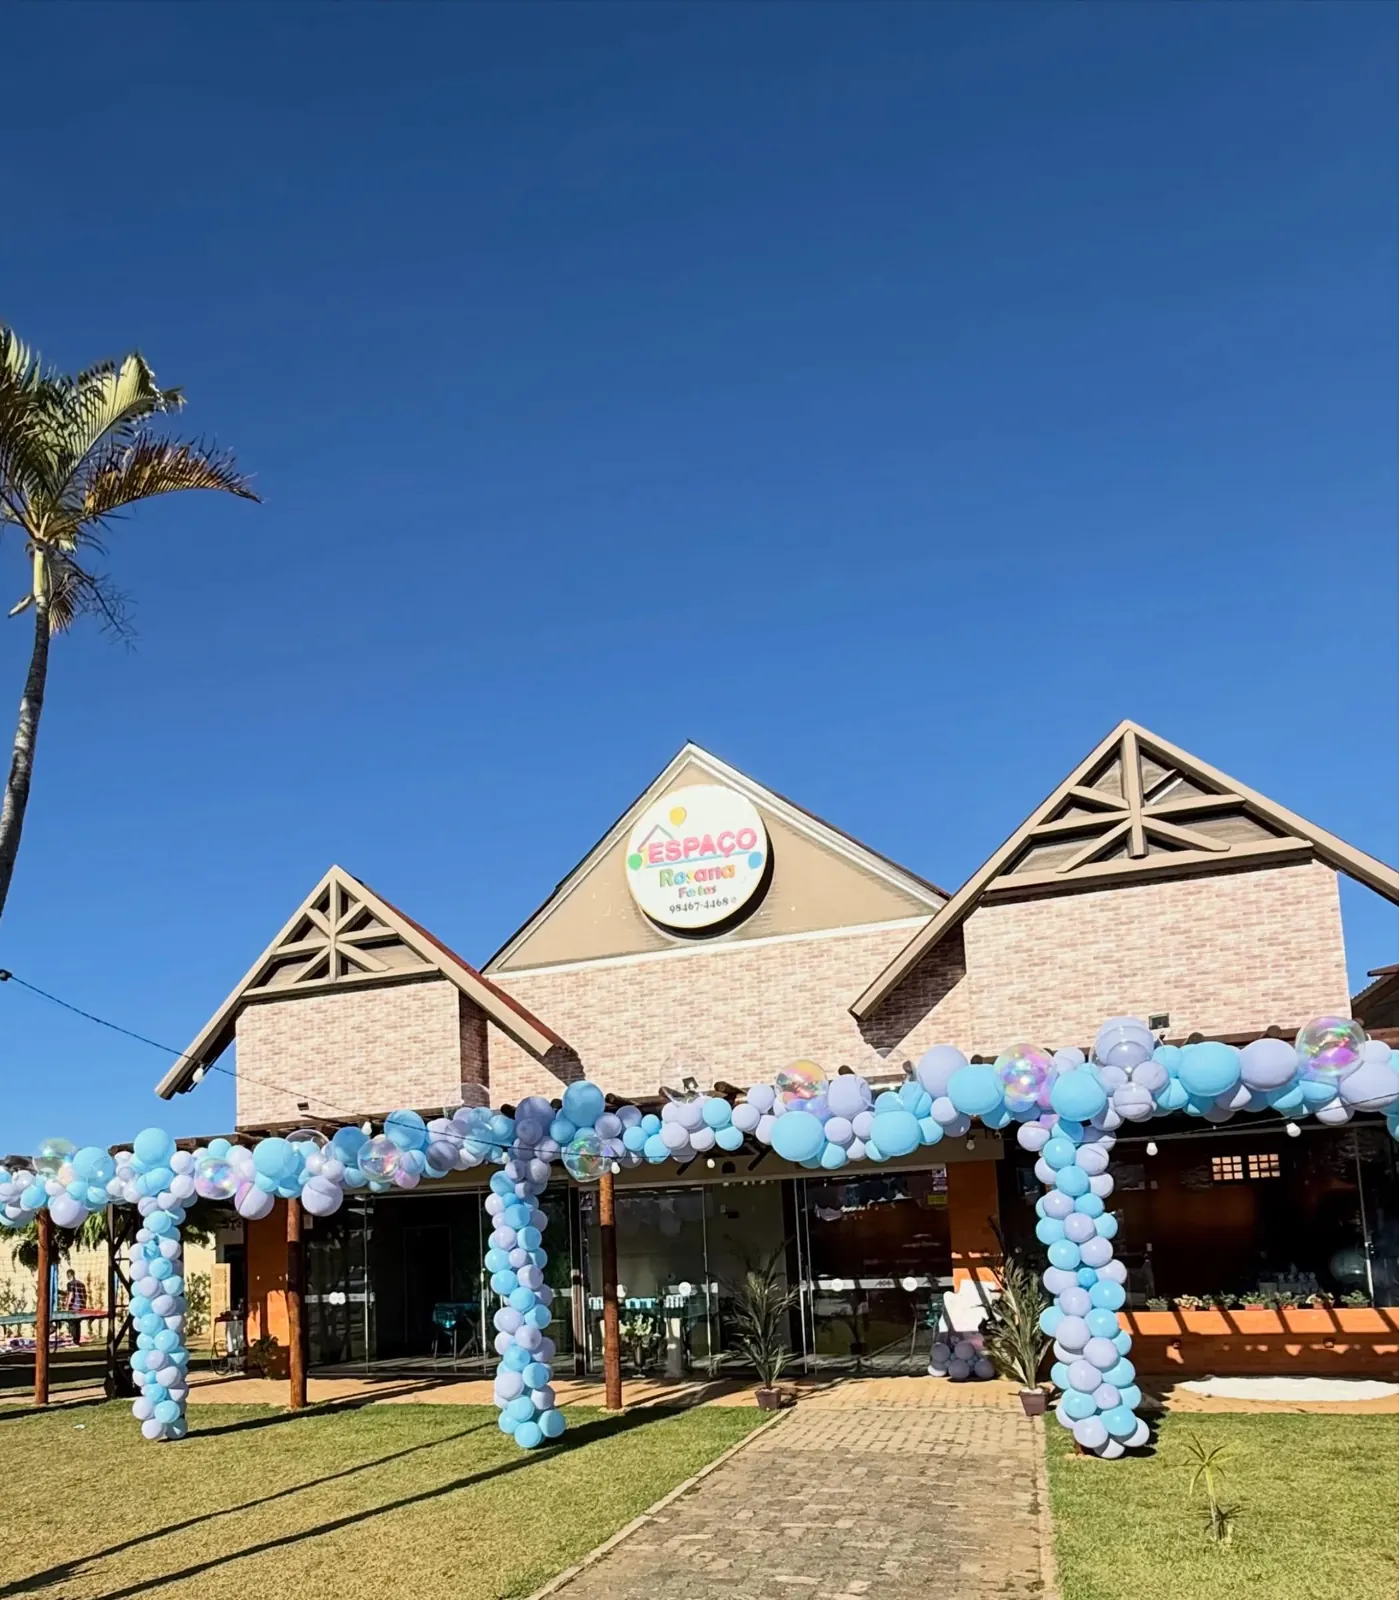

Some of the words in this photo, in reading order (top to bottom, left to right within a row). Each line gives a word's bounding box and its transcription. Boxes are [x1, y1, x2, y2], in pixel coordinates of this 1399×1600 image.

[648, 828, 757, 864] ESPAÇO
[659, 864, 736, 887] Rosana
[678, 885, 717, 899] Fetas
[669, 897, 729, 914] 98467-4468
